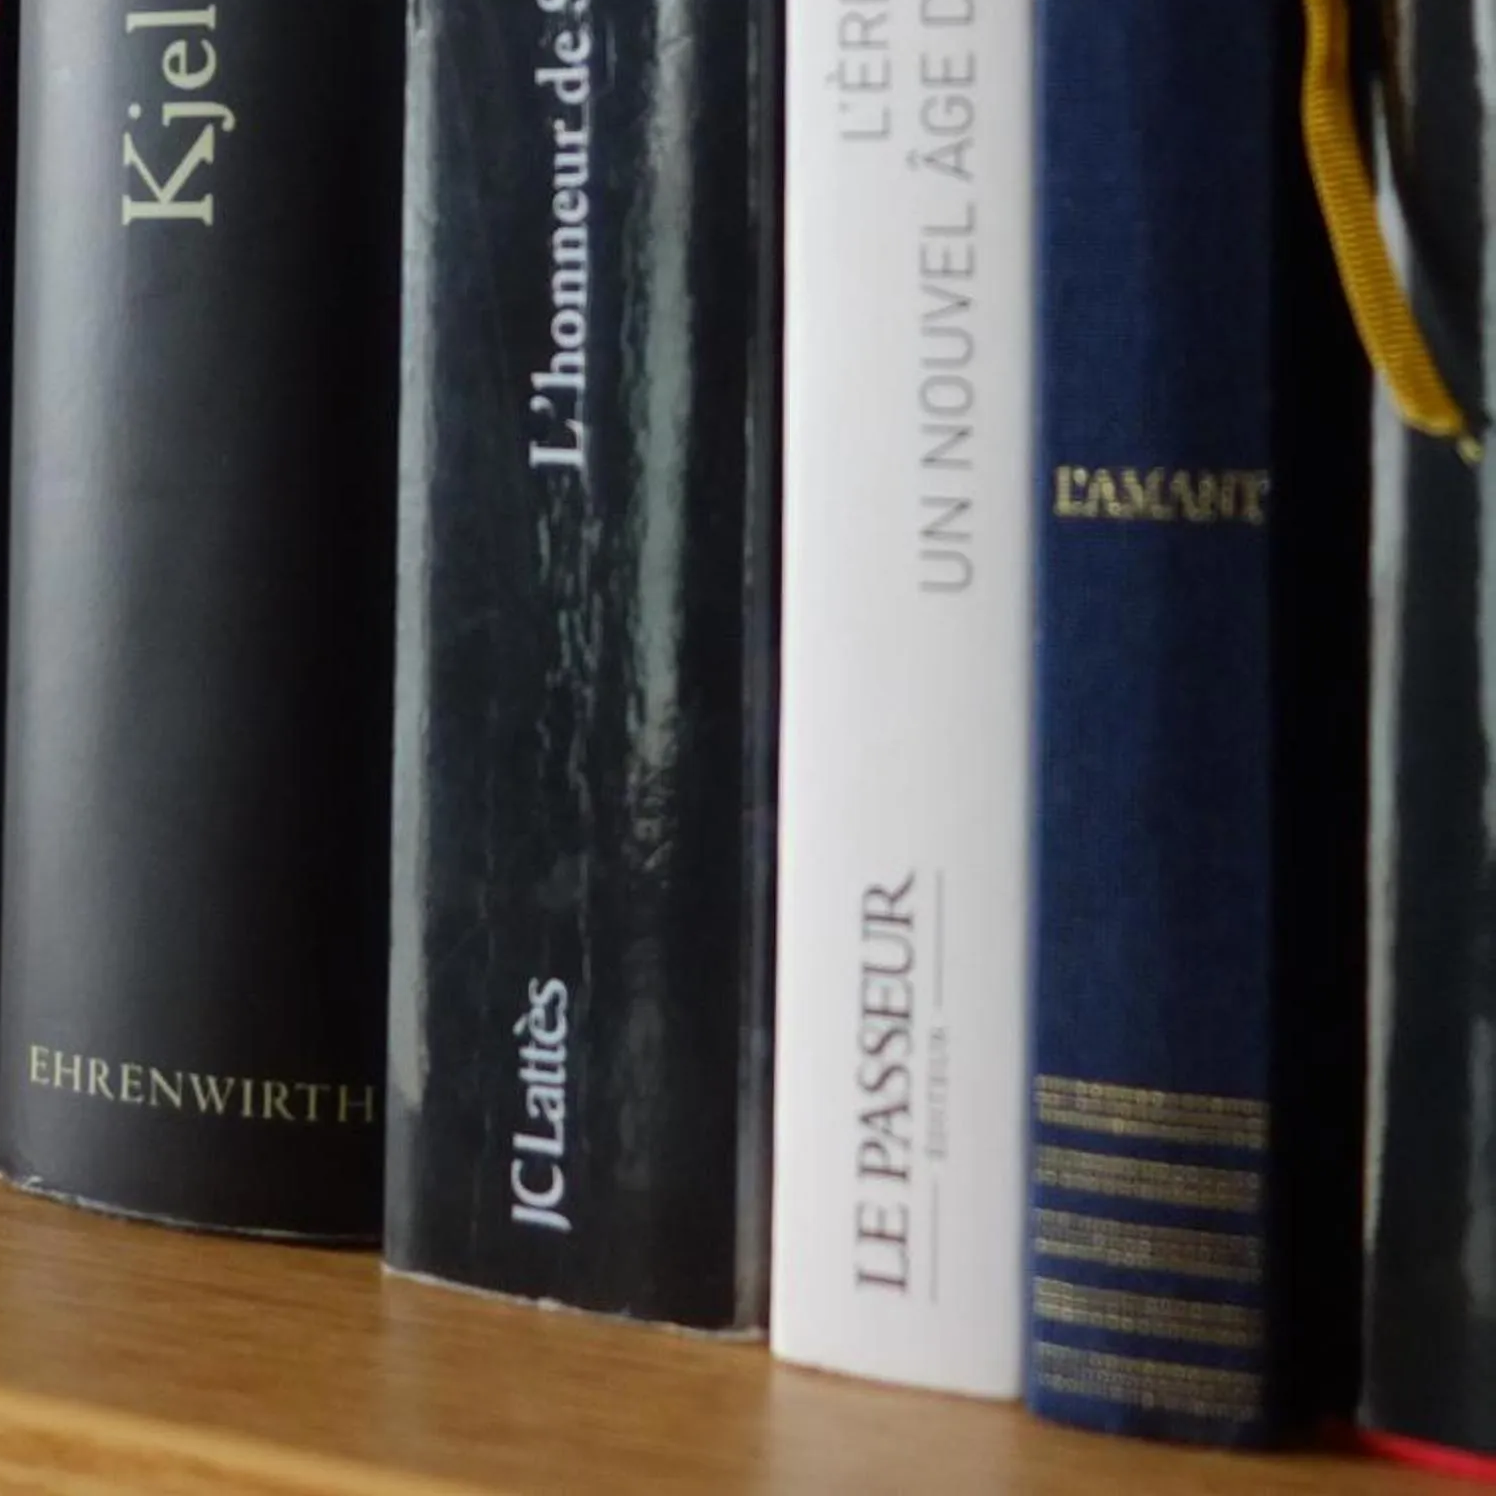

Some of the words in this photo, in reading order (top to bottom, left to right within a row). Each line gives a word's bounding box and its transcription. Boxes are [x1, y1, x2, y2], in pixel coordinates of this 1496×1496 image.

[536, 28, 591, 104] de
[904, 52, 976, 185] ÂGE
[529, 118, 590, 471] L'honneur
[917, 200, 977, 471] NOUVEL
[918, 495, 976, 594] UN
[855, 868, 917, 1180] PASSEUR
[29, 1044, 377, 1123] EHRENWIRTH
[855, 1201, 910, 1294] LE
